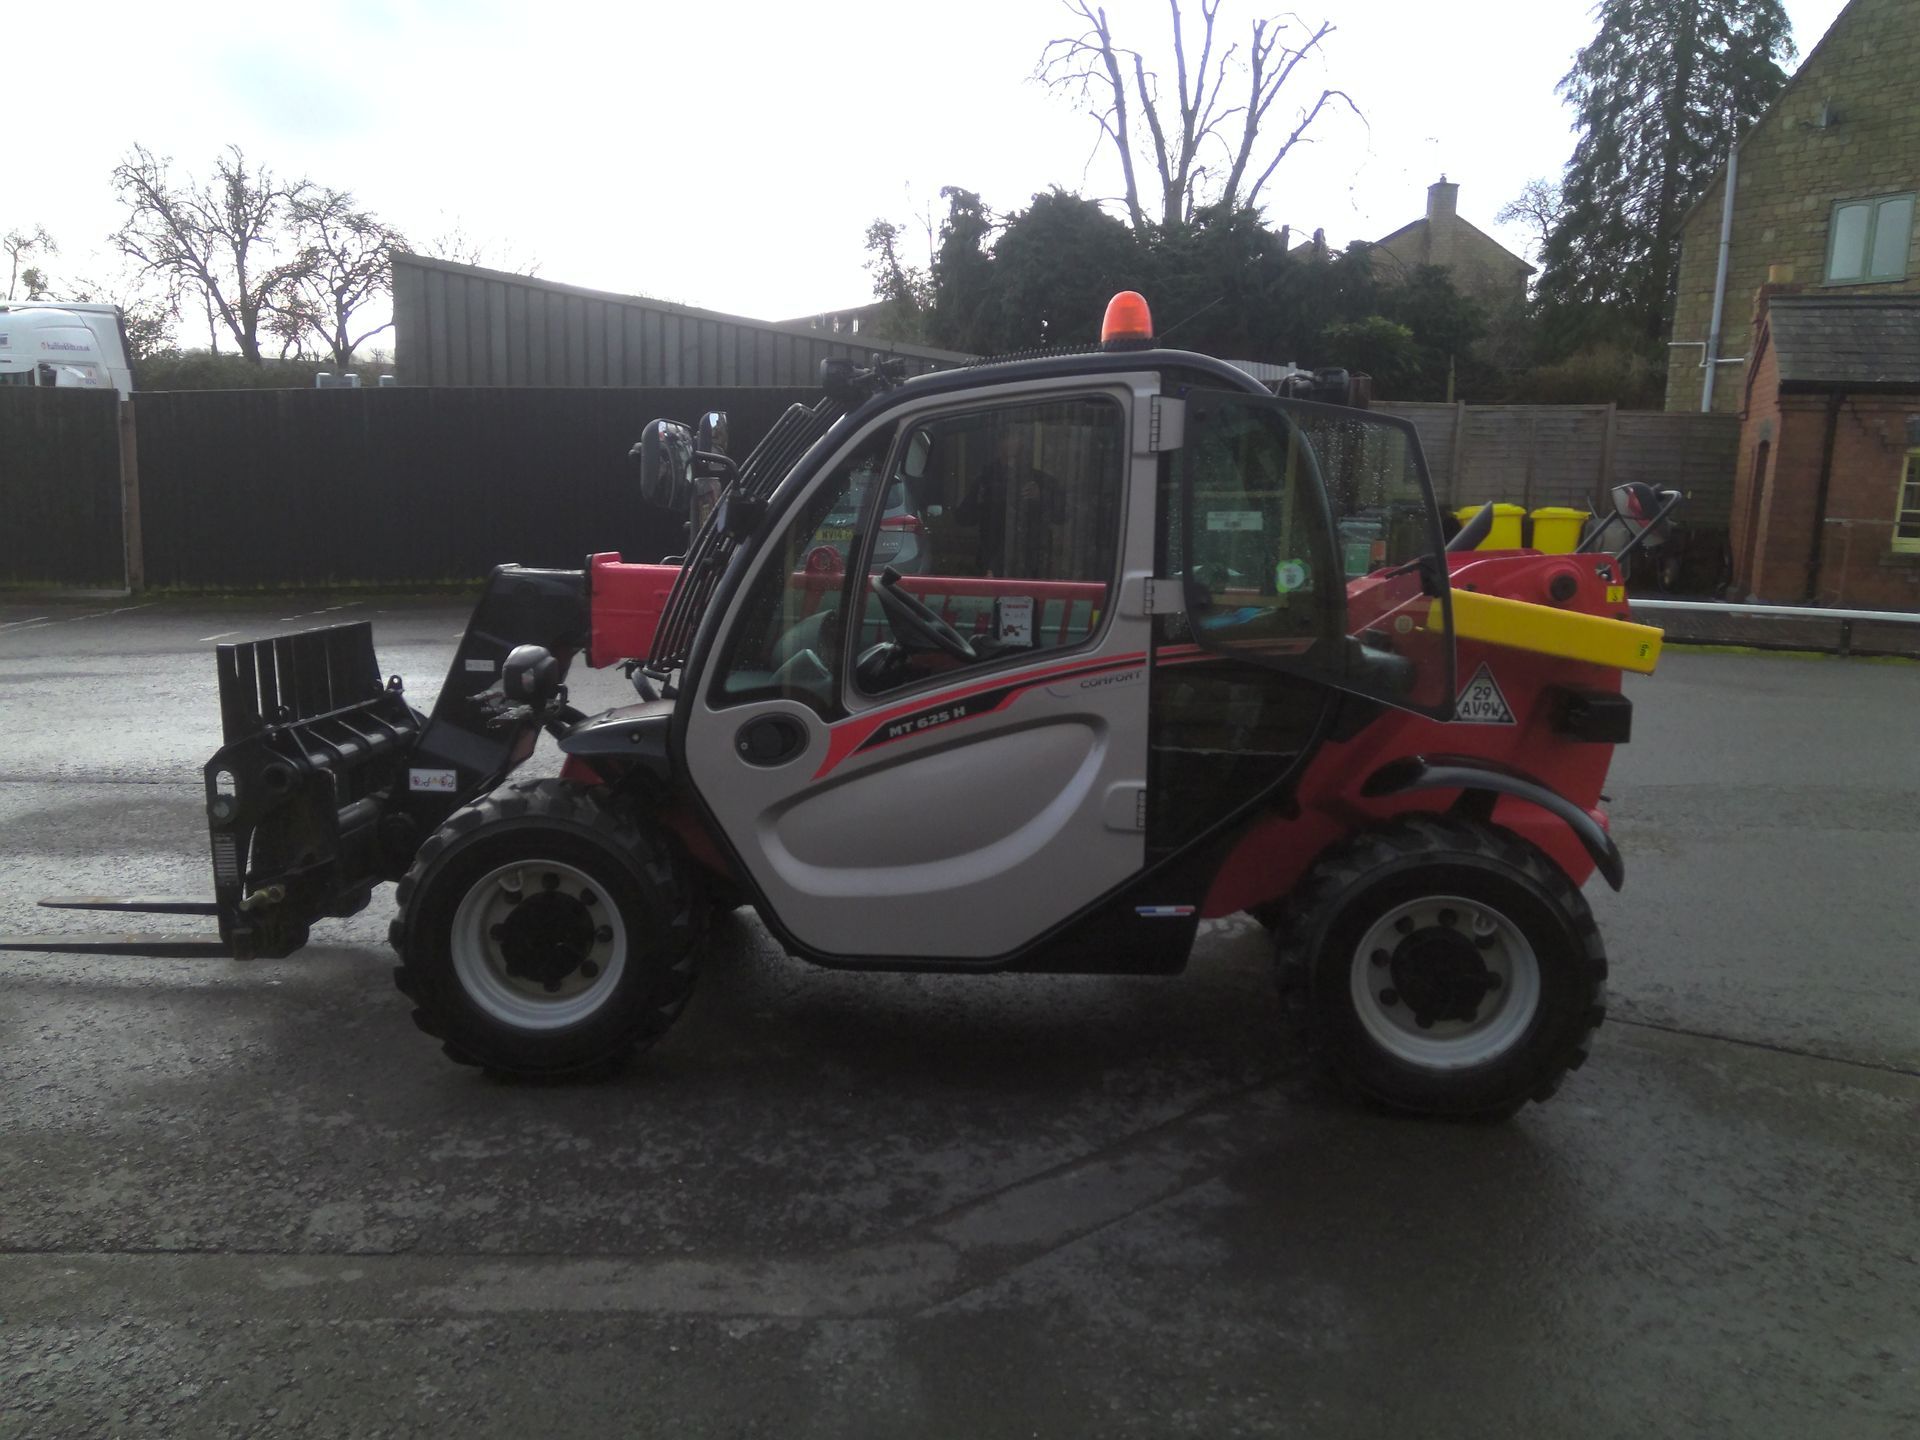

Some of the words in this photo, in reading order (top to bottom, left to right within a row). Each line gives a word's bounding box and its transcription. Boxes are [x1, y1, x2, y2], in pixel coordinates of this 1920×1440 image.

[1079, 669, 1143, 689] COMFORT
[1473, 686, 1492, 701] 29
[889, 721, 914, 738] MT
[916, 711, 950, 729] 625
[953, 705, 967, 718] H
